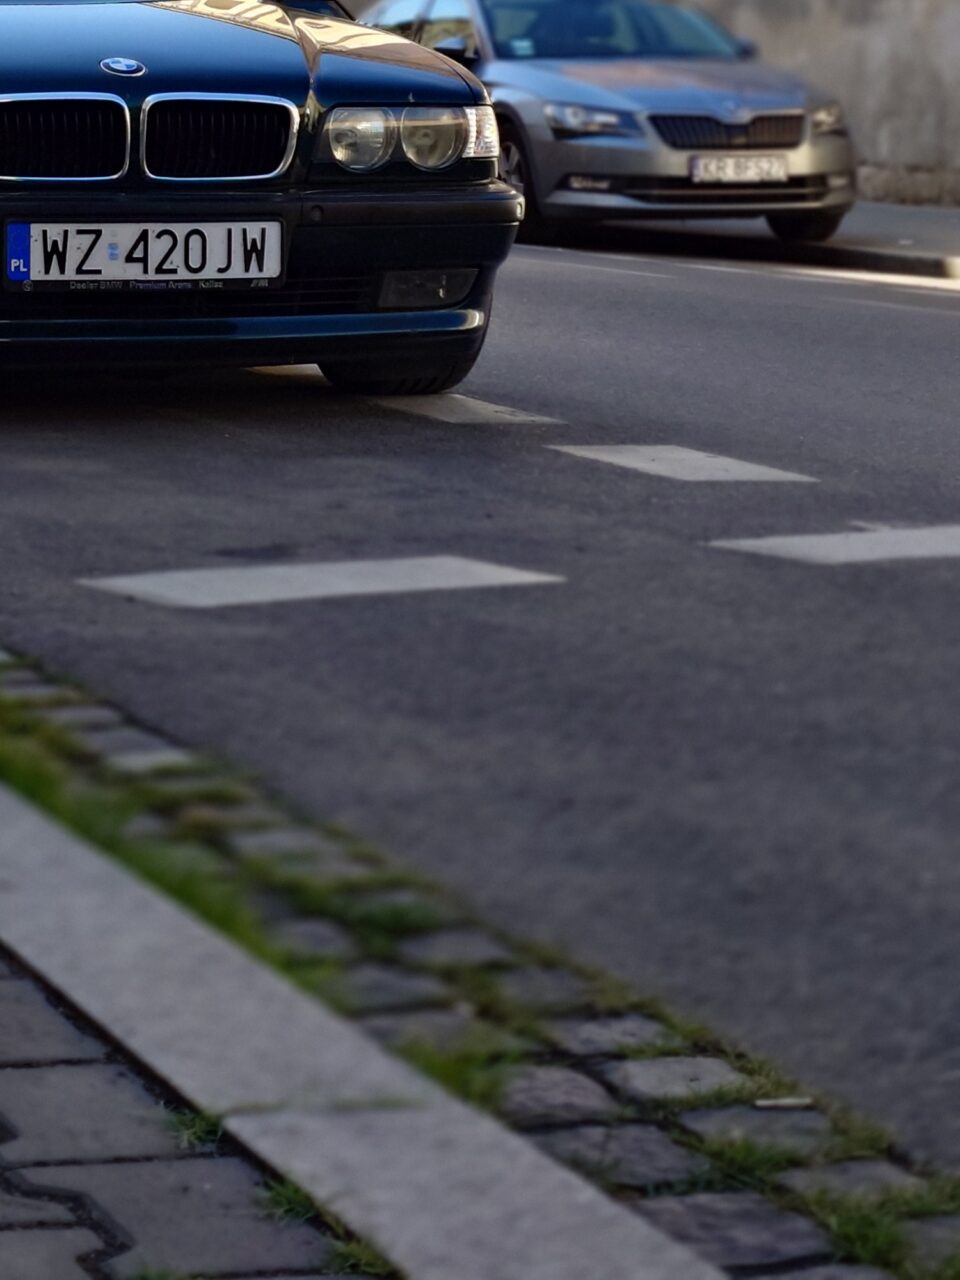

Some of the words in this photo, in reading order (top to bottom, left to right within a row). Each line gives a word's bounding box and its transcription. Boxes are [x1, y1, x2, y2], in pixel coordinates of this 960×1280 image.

[10, 259, 28, 272] PL
[41, 228, 103, 275] WZ
[124, 227, 267, 275] 420JW
